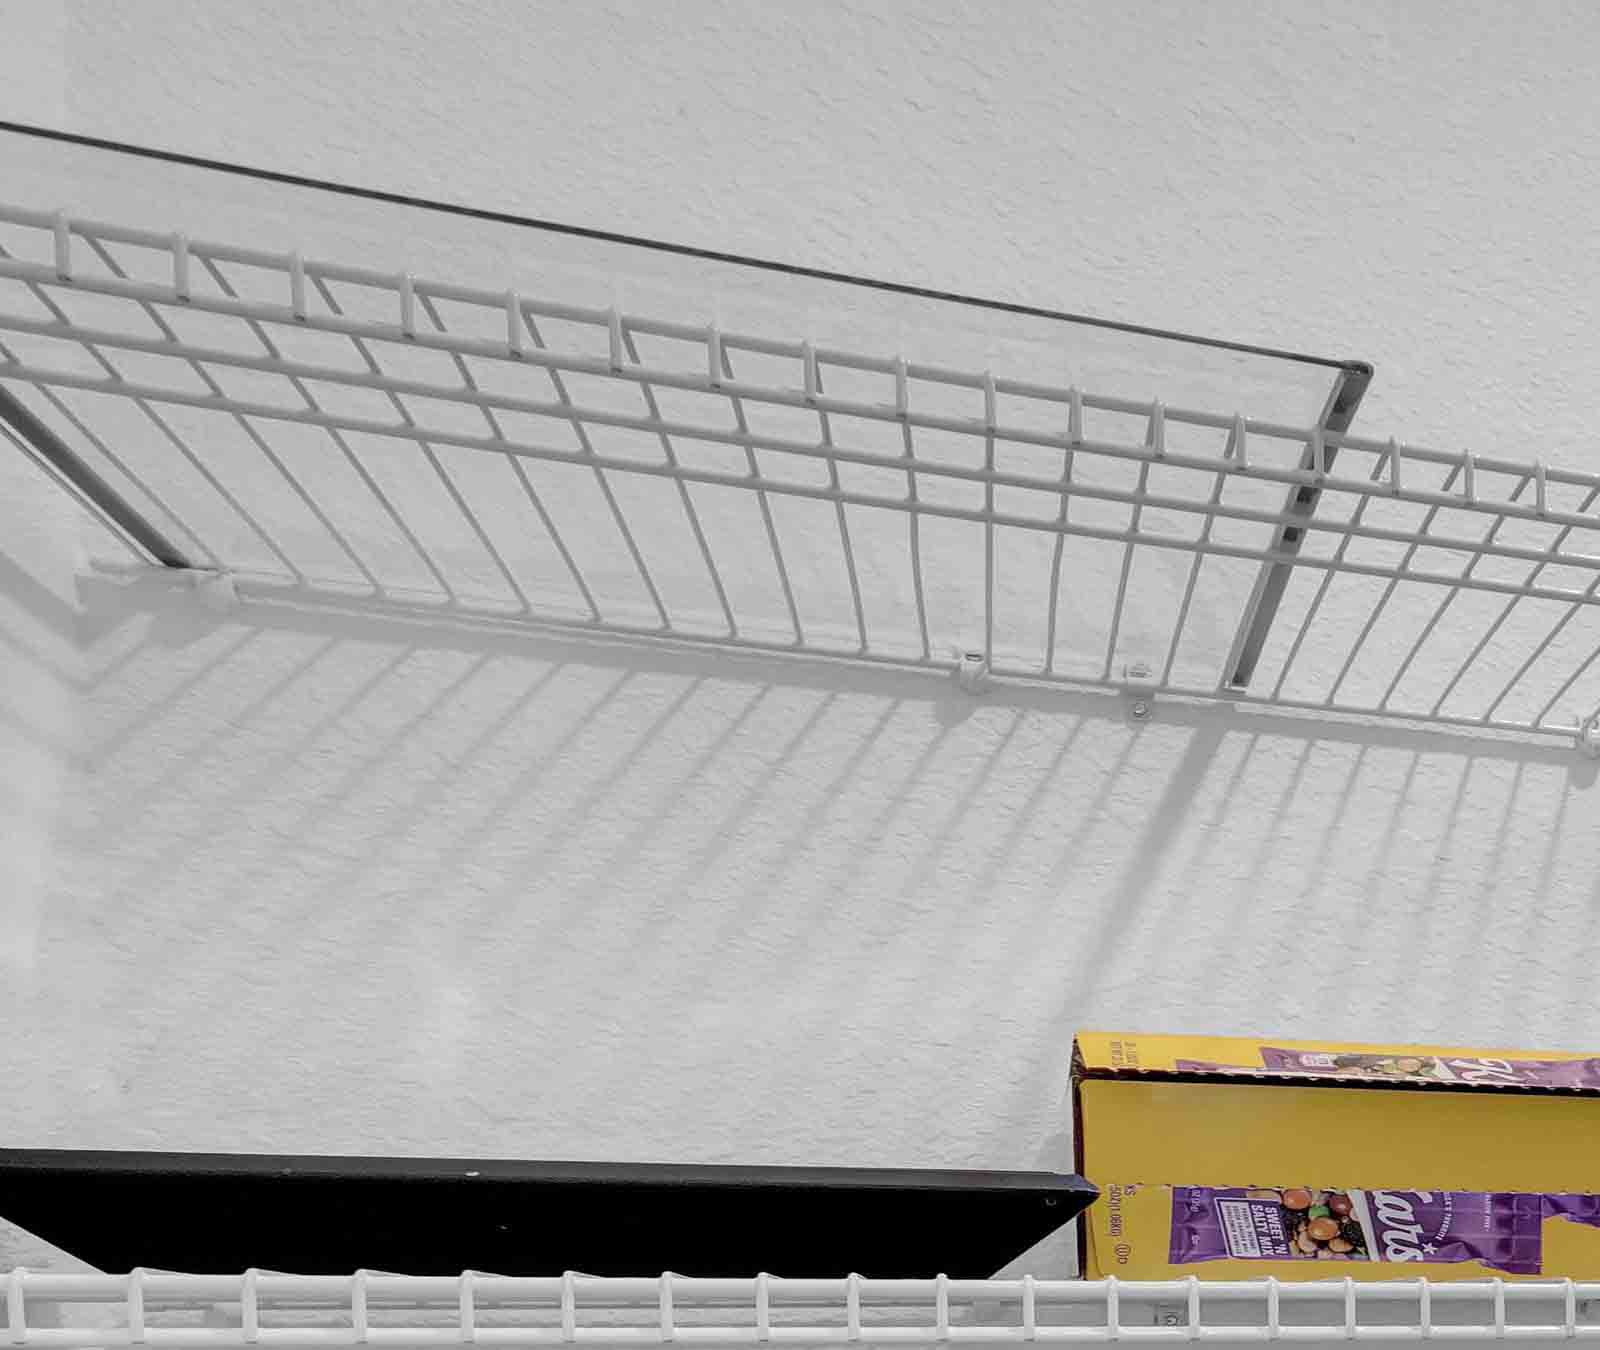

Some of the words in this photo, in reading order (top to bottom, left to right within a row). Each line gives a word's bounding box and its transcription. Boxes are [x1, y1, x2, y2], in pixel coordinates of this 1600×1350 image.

[1251, 1204, 1270, 1237] SALTY
[1265, 1207, 1285, 1241] SWEET
[1260, 1237, 1275, 1256] MIX
